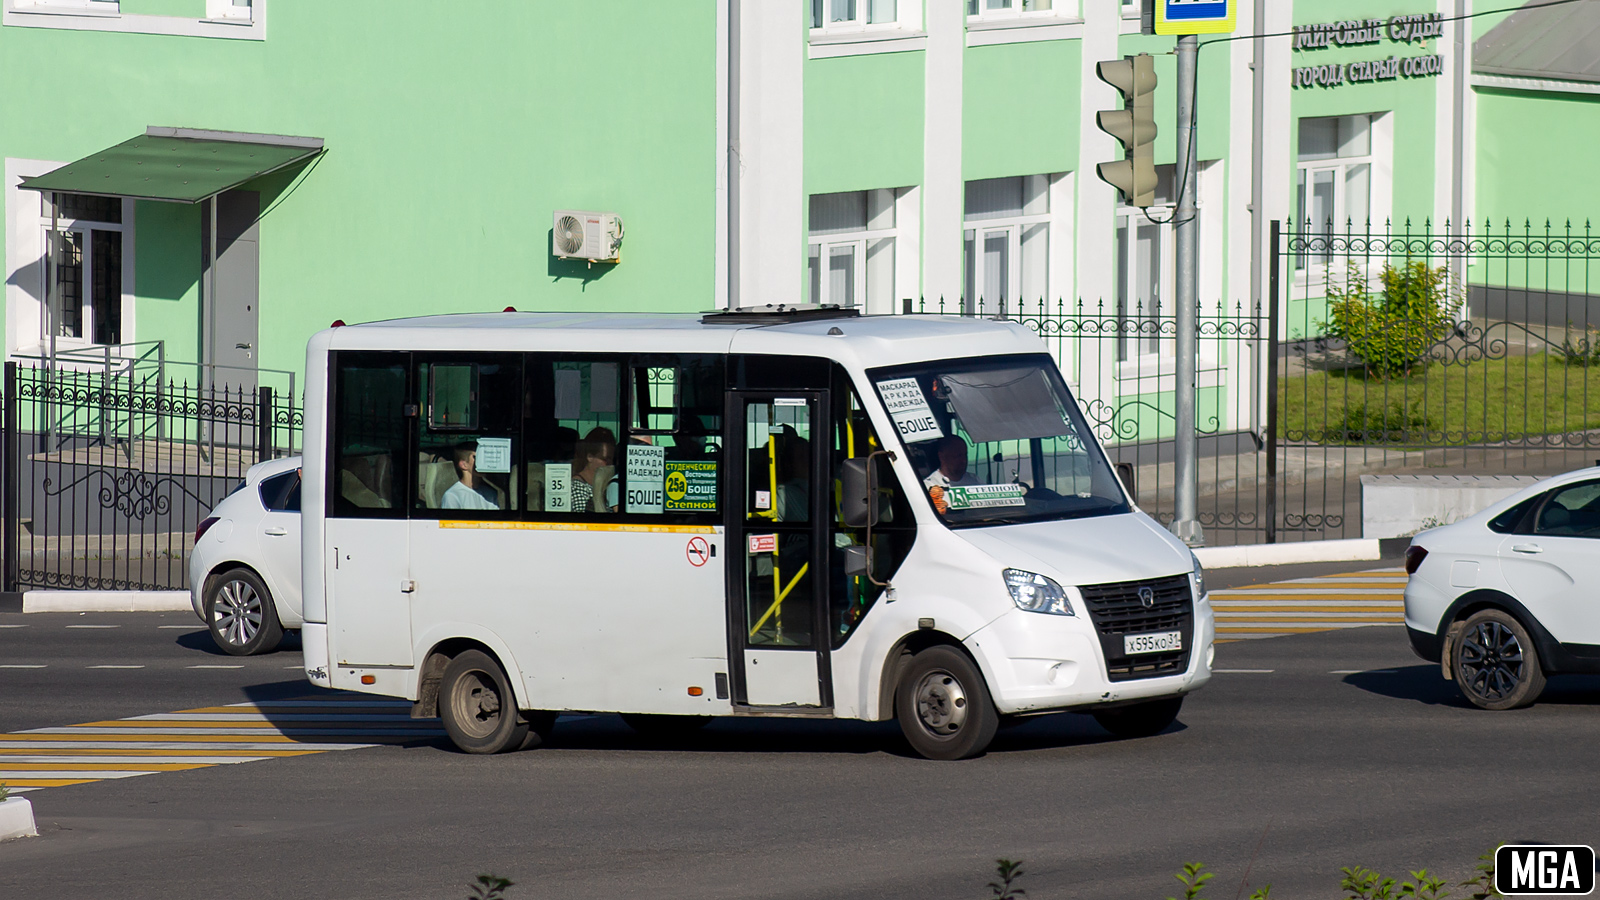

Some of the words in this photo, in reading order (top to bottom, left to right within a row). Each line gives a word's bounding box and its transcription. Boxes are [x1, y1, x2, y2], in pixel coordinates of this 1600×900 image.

[1293, 18, 1382, 50] МИРОВЫЕ
[1389, 13, 1444, 43] СУДЬИ
[1294, 64, 1344, 87] ГОРОДА
[1348, 56, 1400, 82] СТАРЫЙ
[1402, 55, 1444, 77] ОСКОЛ
[879, 381, 917, 392] МАСКАРАД
[884, 390, 921, 400] АРКАДА
[888, 398, 925, 409] НАДЕЖДА
[897, 416, 937, 434] БОШЕ
[629, 449, 662, 457] МАСКАРАД
[628, 459, 662, 467] АРКАДА
[628, 469, 662, 477] НАДЕЖДА
[685, 470, 717, 478] Восточный
[667, 478, 685, 492] 25а
[687, 485, 717, 494] БОШЕ
[628, 490, 662, 505] БОШЕ
[666, 500, 716, 509] Степной
[1168, 633, 1178, 645] 31
